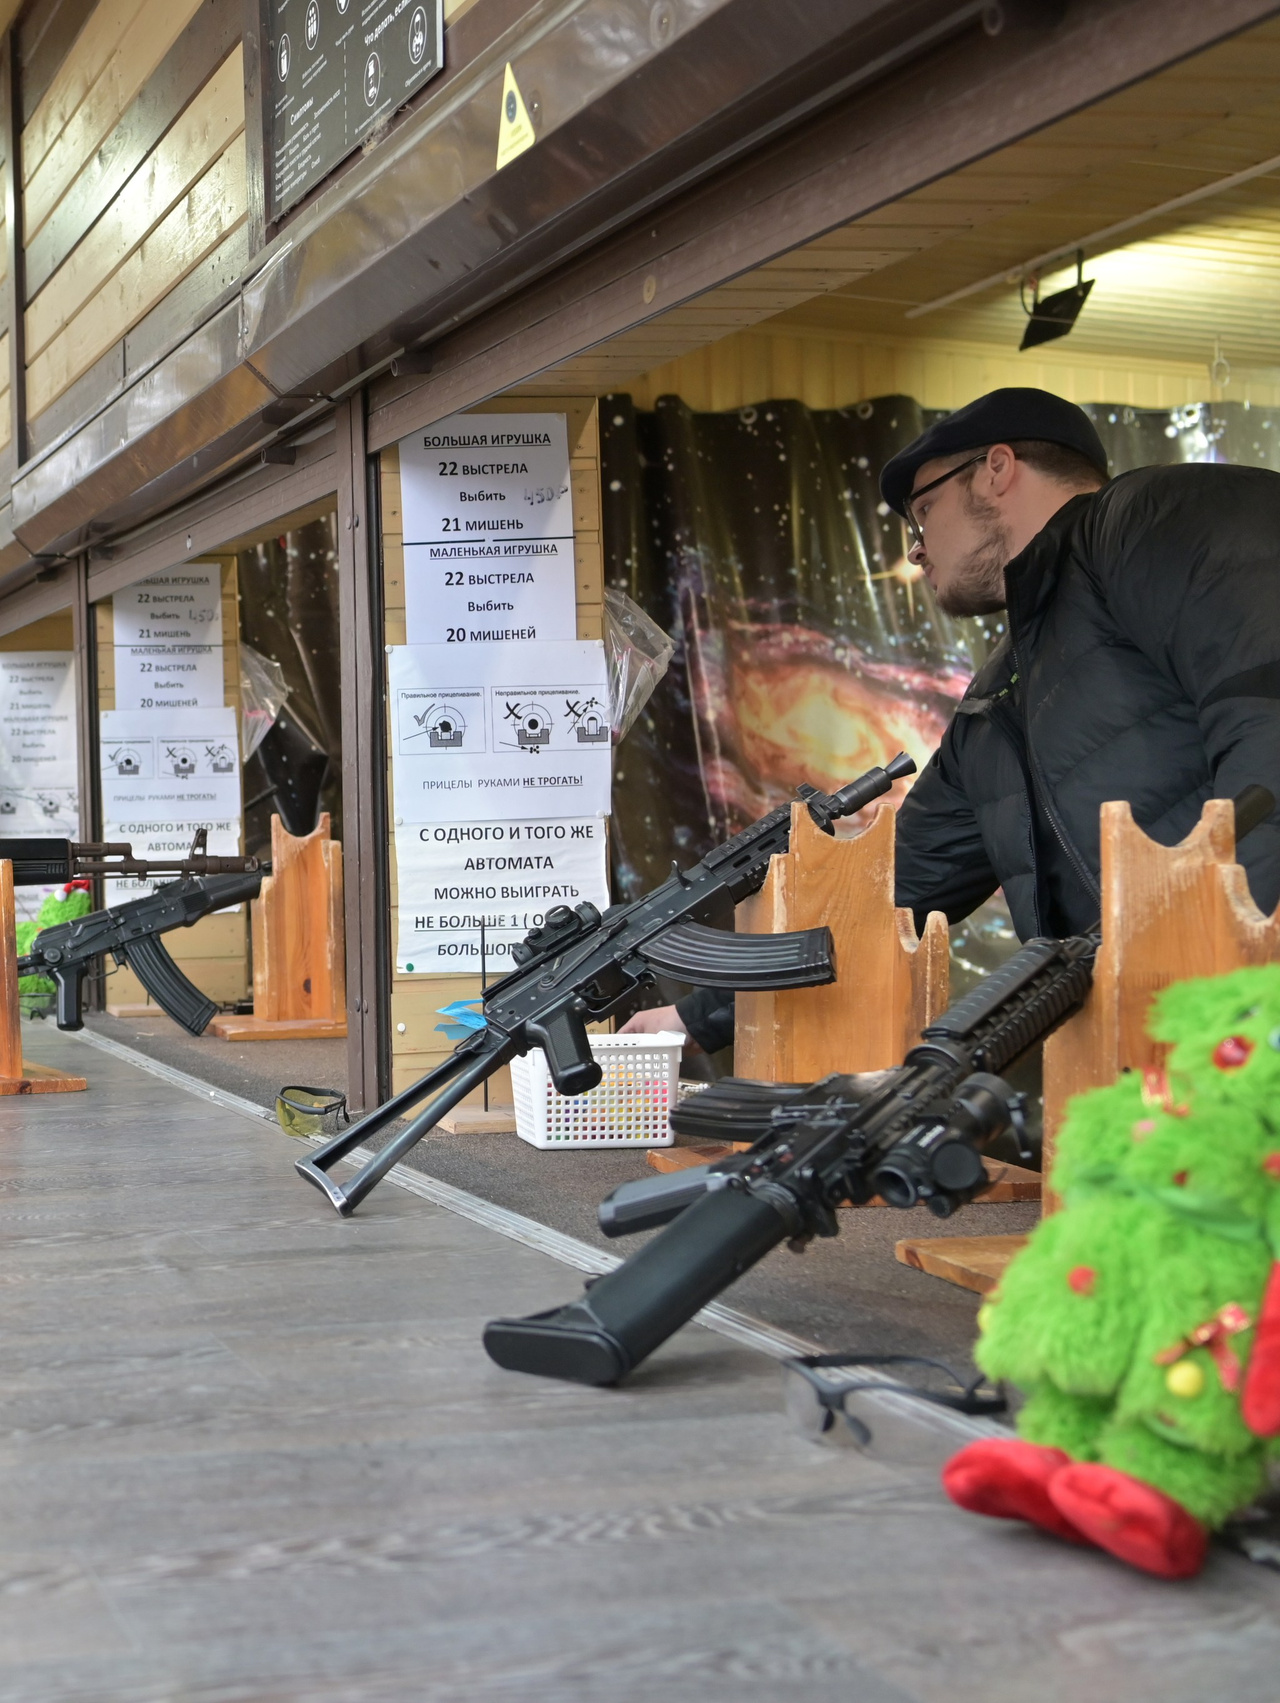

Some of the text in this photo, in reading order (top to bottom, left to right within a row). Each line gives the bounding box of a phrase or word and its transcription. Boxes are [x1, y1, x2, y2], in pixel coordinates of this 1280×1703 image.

[423, 433, 552, 448] БОЛЬШАЯ ИГРУШКА
[438, 461, 528, 477] 22 ВЫСТРЕЛА
[459, 490, 506, 502] Выбить
[441, 517, 524, 532] 21 МИШЕНЬ
[429, 543, 558, 559] МАЛЕНЬКАЯ ИГРУШКА
[171, 575, 210, 585] ИГРУШКА
[444, 571, 535, 586] 22 ВЫСТРЕЛА
[137, 594, 195, 604] 22 ВЫСТРЕЛА
[467, 600, 515, 613] Выбить
[138, 629, 191, 638] 21 МИШЕНЬ
[446, 626, 536, 643] 20 МИШЕНЕЙ
[140, 663, 197, 672] 22 ВЫСТРЕЛА
[154, 681, 184, 689] Выбить
[140, 698, 198, 708] 20 МИШЕНЕЙ
[422, 775, 583, 791] ПРИЦЕЛЫ РУКАМИ НЕ ТРОГАТЬ!
[119, 824, 126, 833] С
[128, 823, 174, 834] ОДНОГО
[176, 823, 184, 832] И
[216, 822, 231, 831] ЖЕ
[419, 825, 594, 844] С ОДНОГО И ТОГО ЖЕ
[147, 842, 193, 851] АВТОМА
[464, 856, 554, 871] АВТОМАТА
[434, 885, 579, 900] МОЖНО ВЫИГРАТЬ
[415, 916, 434, 928] НЕ
[439, 915, 506, 929] БОЛЬШЕ
[510, 914, 518, 927] 1
